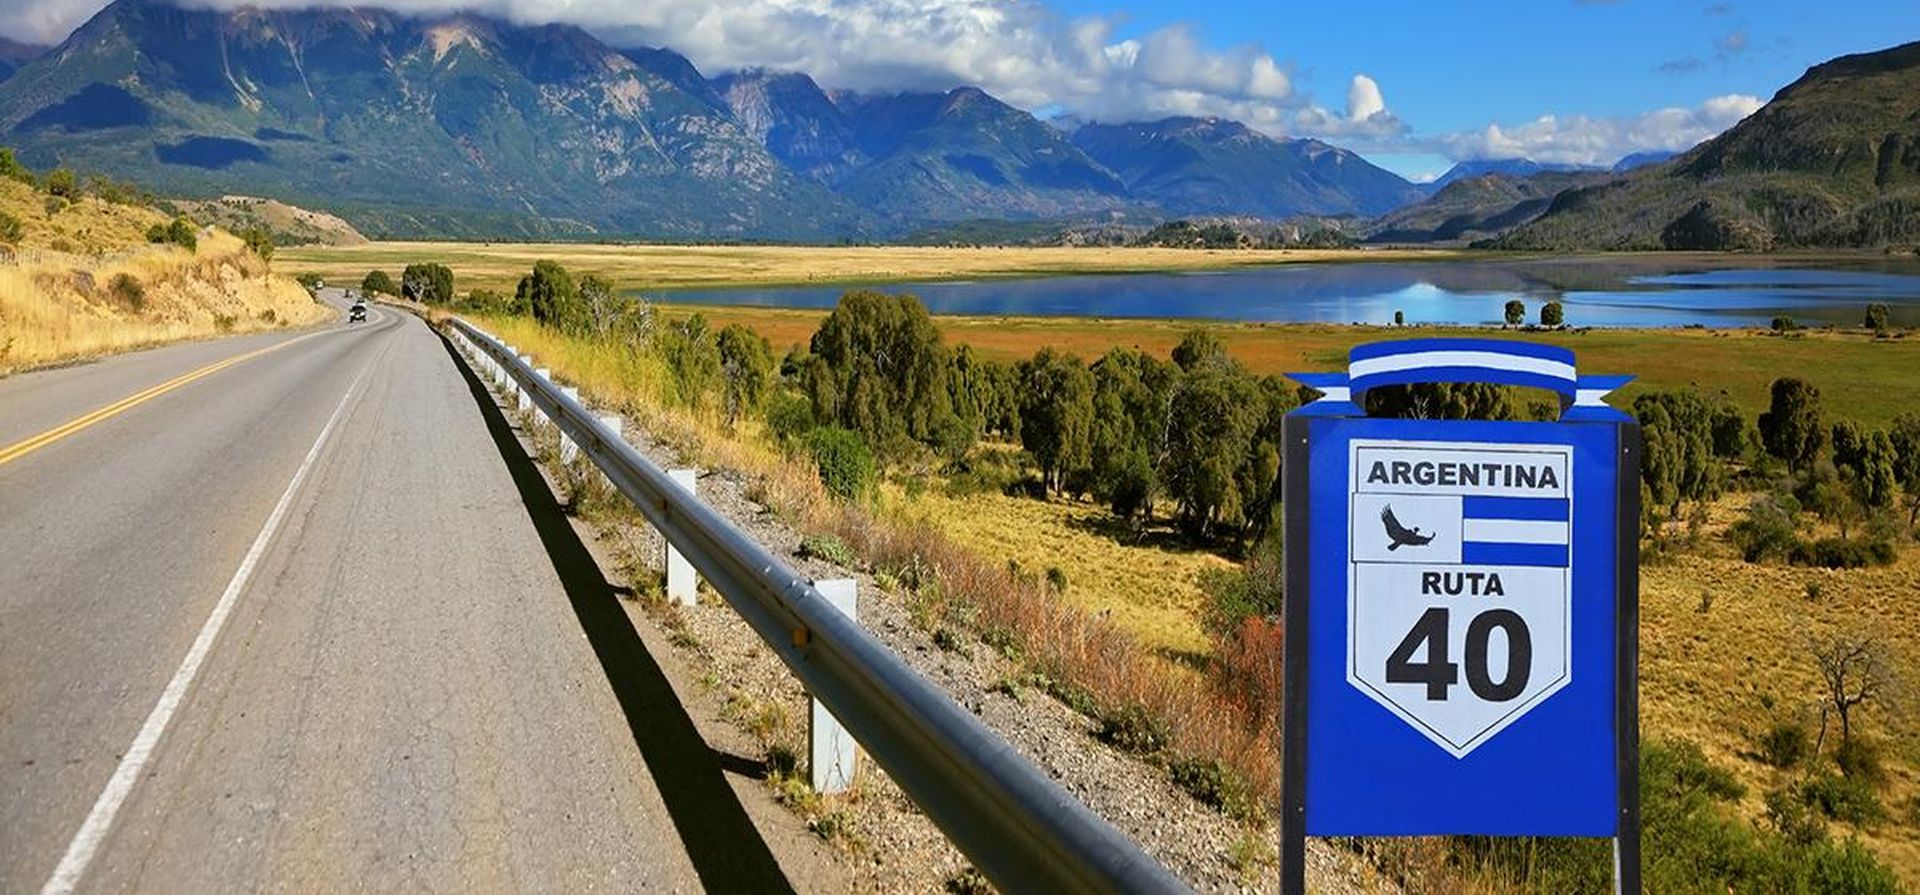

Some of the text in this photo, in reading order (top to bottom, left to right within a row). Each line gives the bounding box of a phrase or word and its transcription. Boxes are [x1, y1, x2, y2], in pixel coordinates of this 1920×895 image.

[1367, 461, 1559, 489] ARGENTINA
[1422, 571, 1504, 596] RUTA
[1385, 607, 1532, 703] 40
